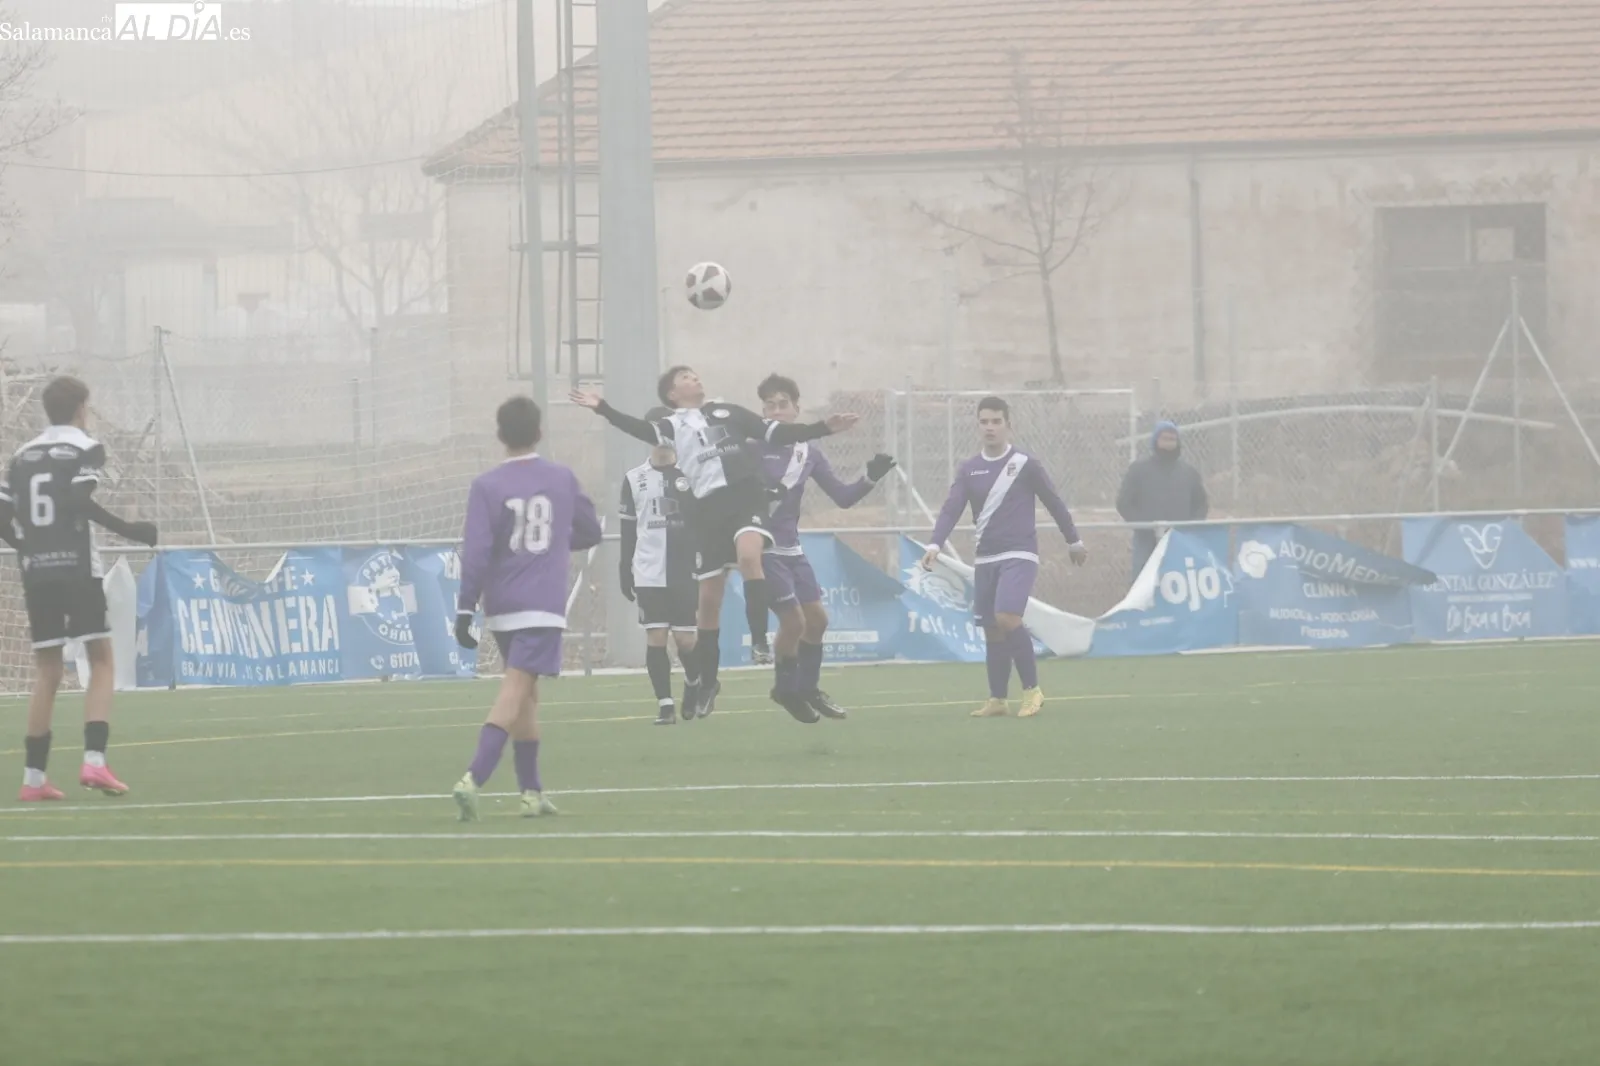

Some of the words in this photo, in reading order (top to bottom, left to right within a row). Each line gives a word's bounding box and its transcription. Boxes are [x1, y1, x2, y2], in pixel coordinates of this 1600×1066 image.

[30, 472, 55, 527] 6
[505, 494, 552, 555] 18
[1160, 557, 1220, 612] ojo
